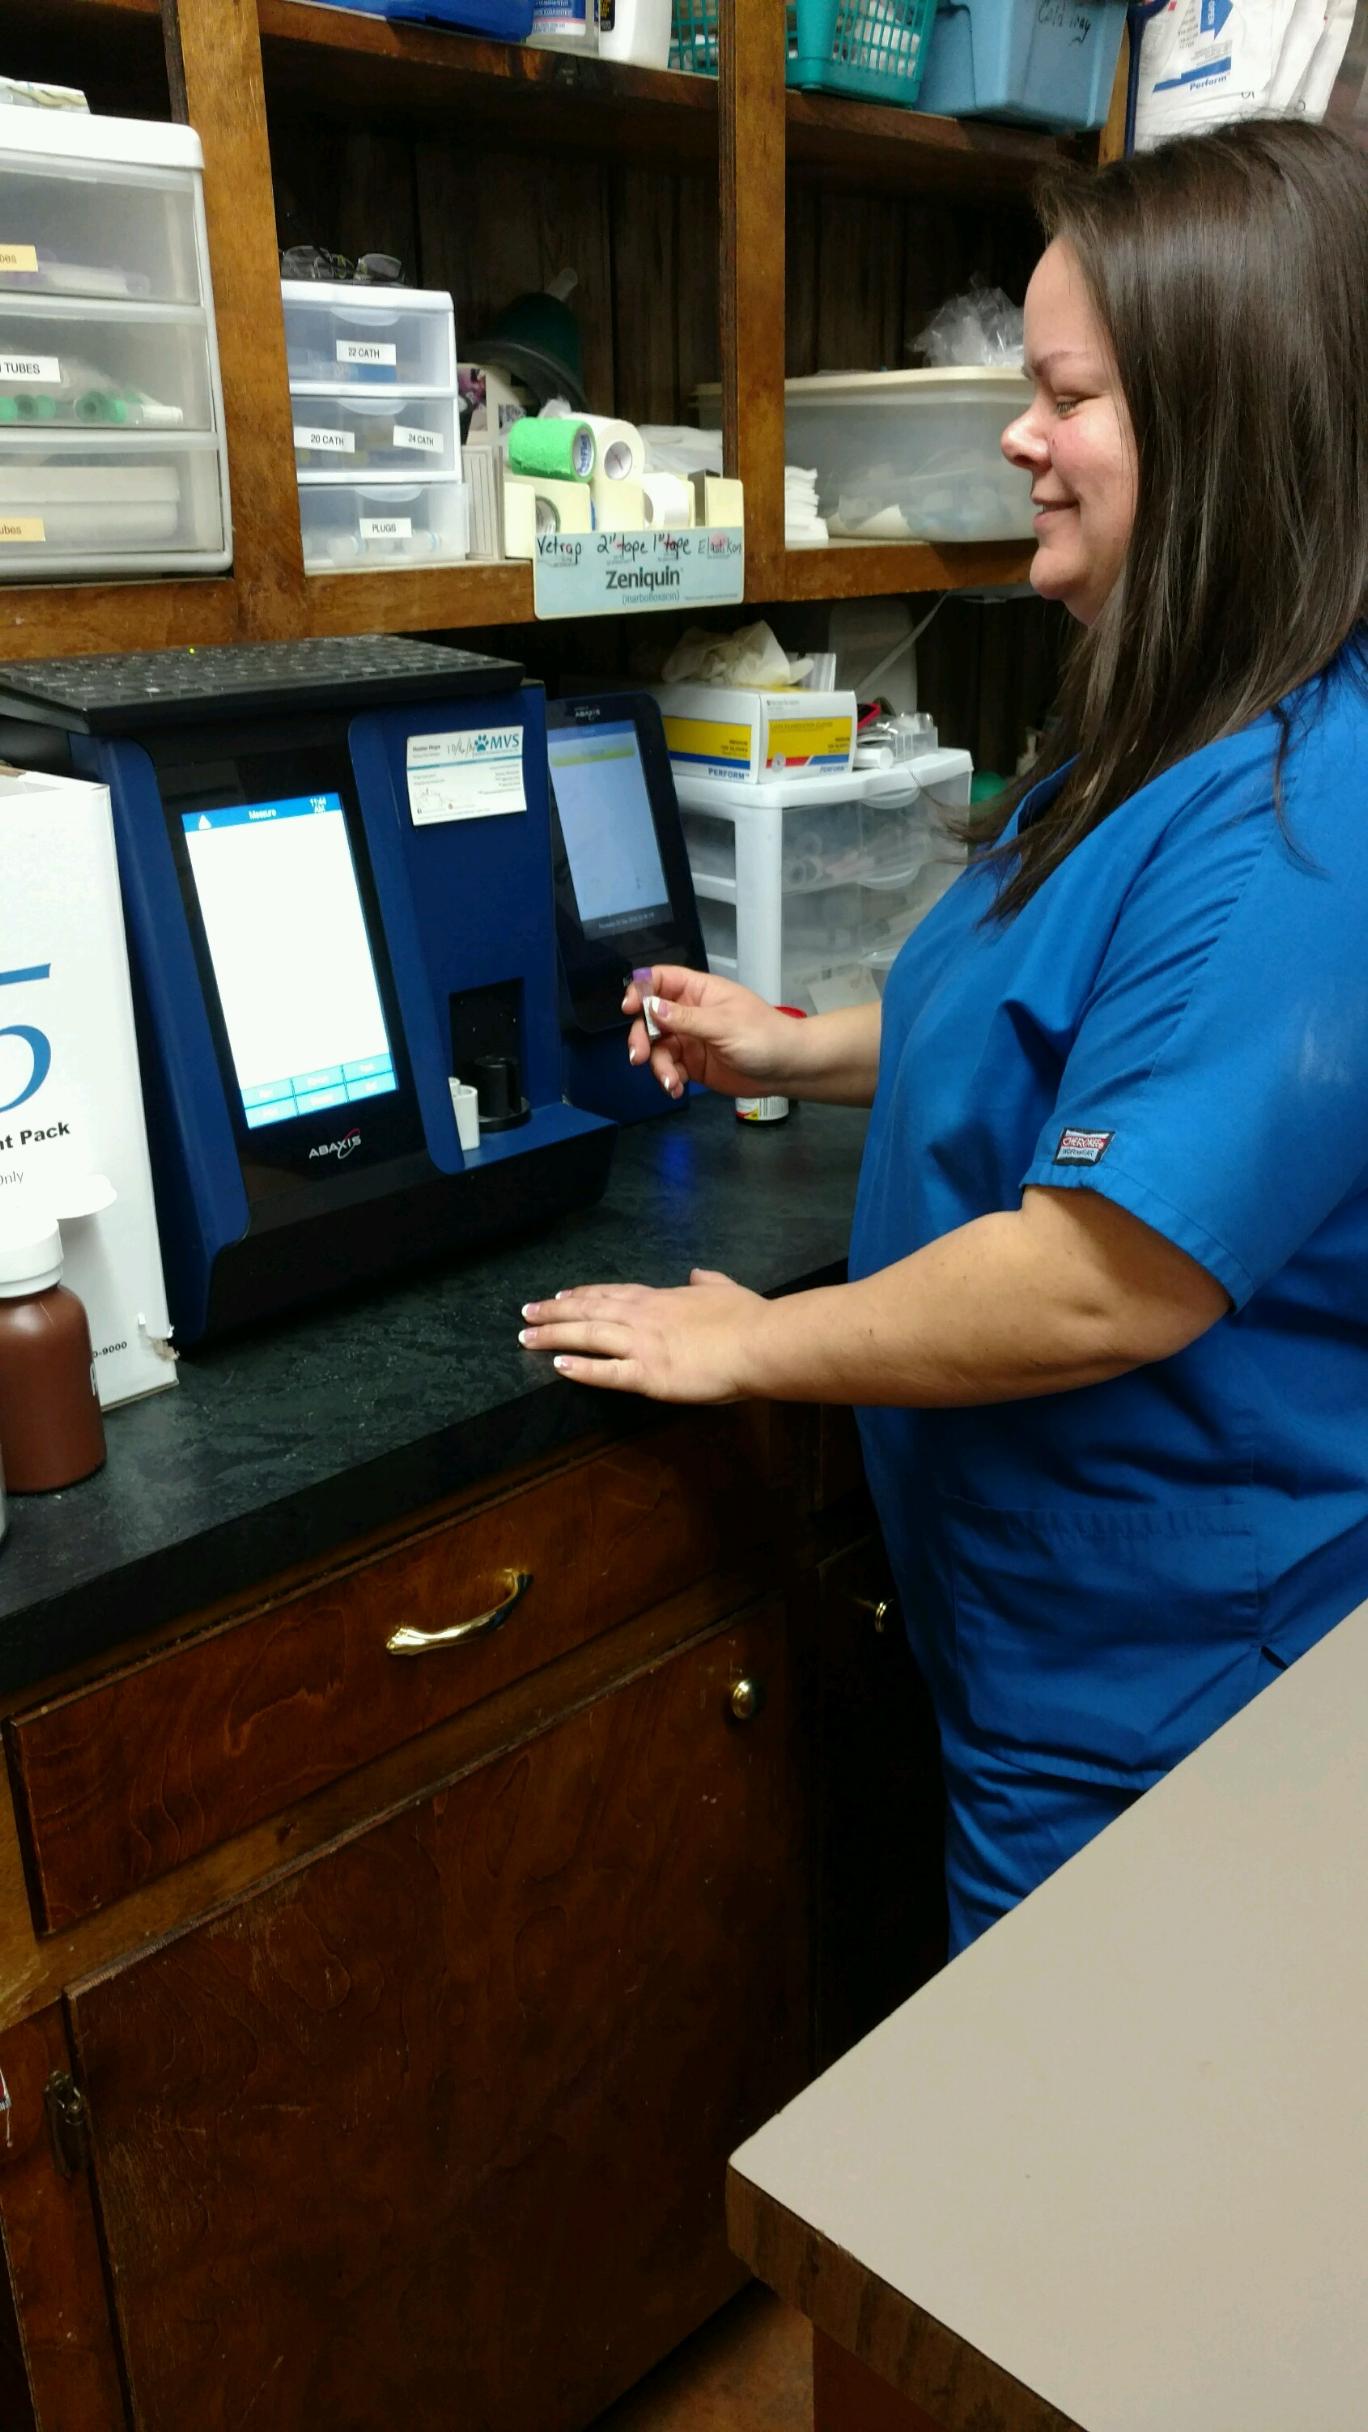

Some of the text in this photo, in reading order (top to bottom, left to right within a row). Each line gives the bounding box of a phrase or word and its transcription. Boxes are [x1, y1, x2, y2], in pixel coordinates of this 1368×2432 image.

[1189, 75, 1228, 92] Perform
[358, 348, 380, 359] CATH
[4, 362, 41, 375] TUBES
[310, 433, 344, 446] 20 CATH
[408, 434, 433, 446] 24 CATH
[371, 523, 397, 533] PLUGS
[537, 535, 582, 565] Vetrap
[605, 565, 681, 591] Zeniquin
[490, 733, 520, 750] MVS
[708, 767, 746, 780] PERFORM
[20, 1121, 71, 1146] Pack
[308, 1129, 363, 1160] ABAXIS
